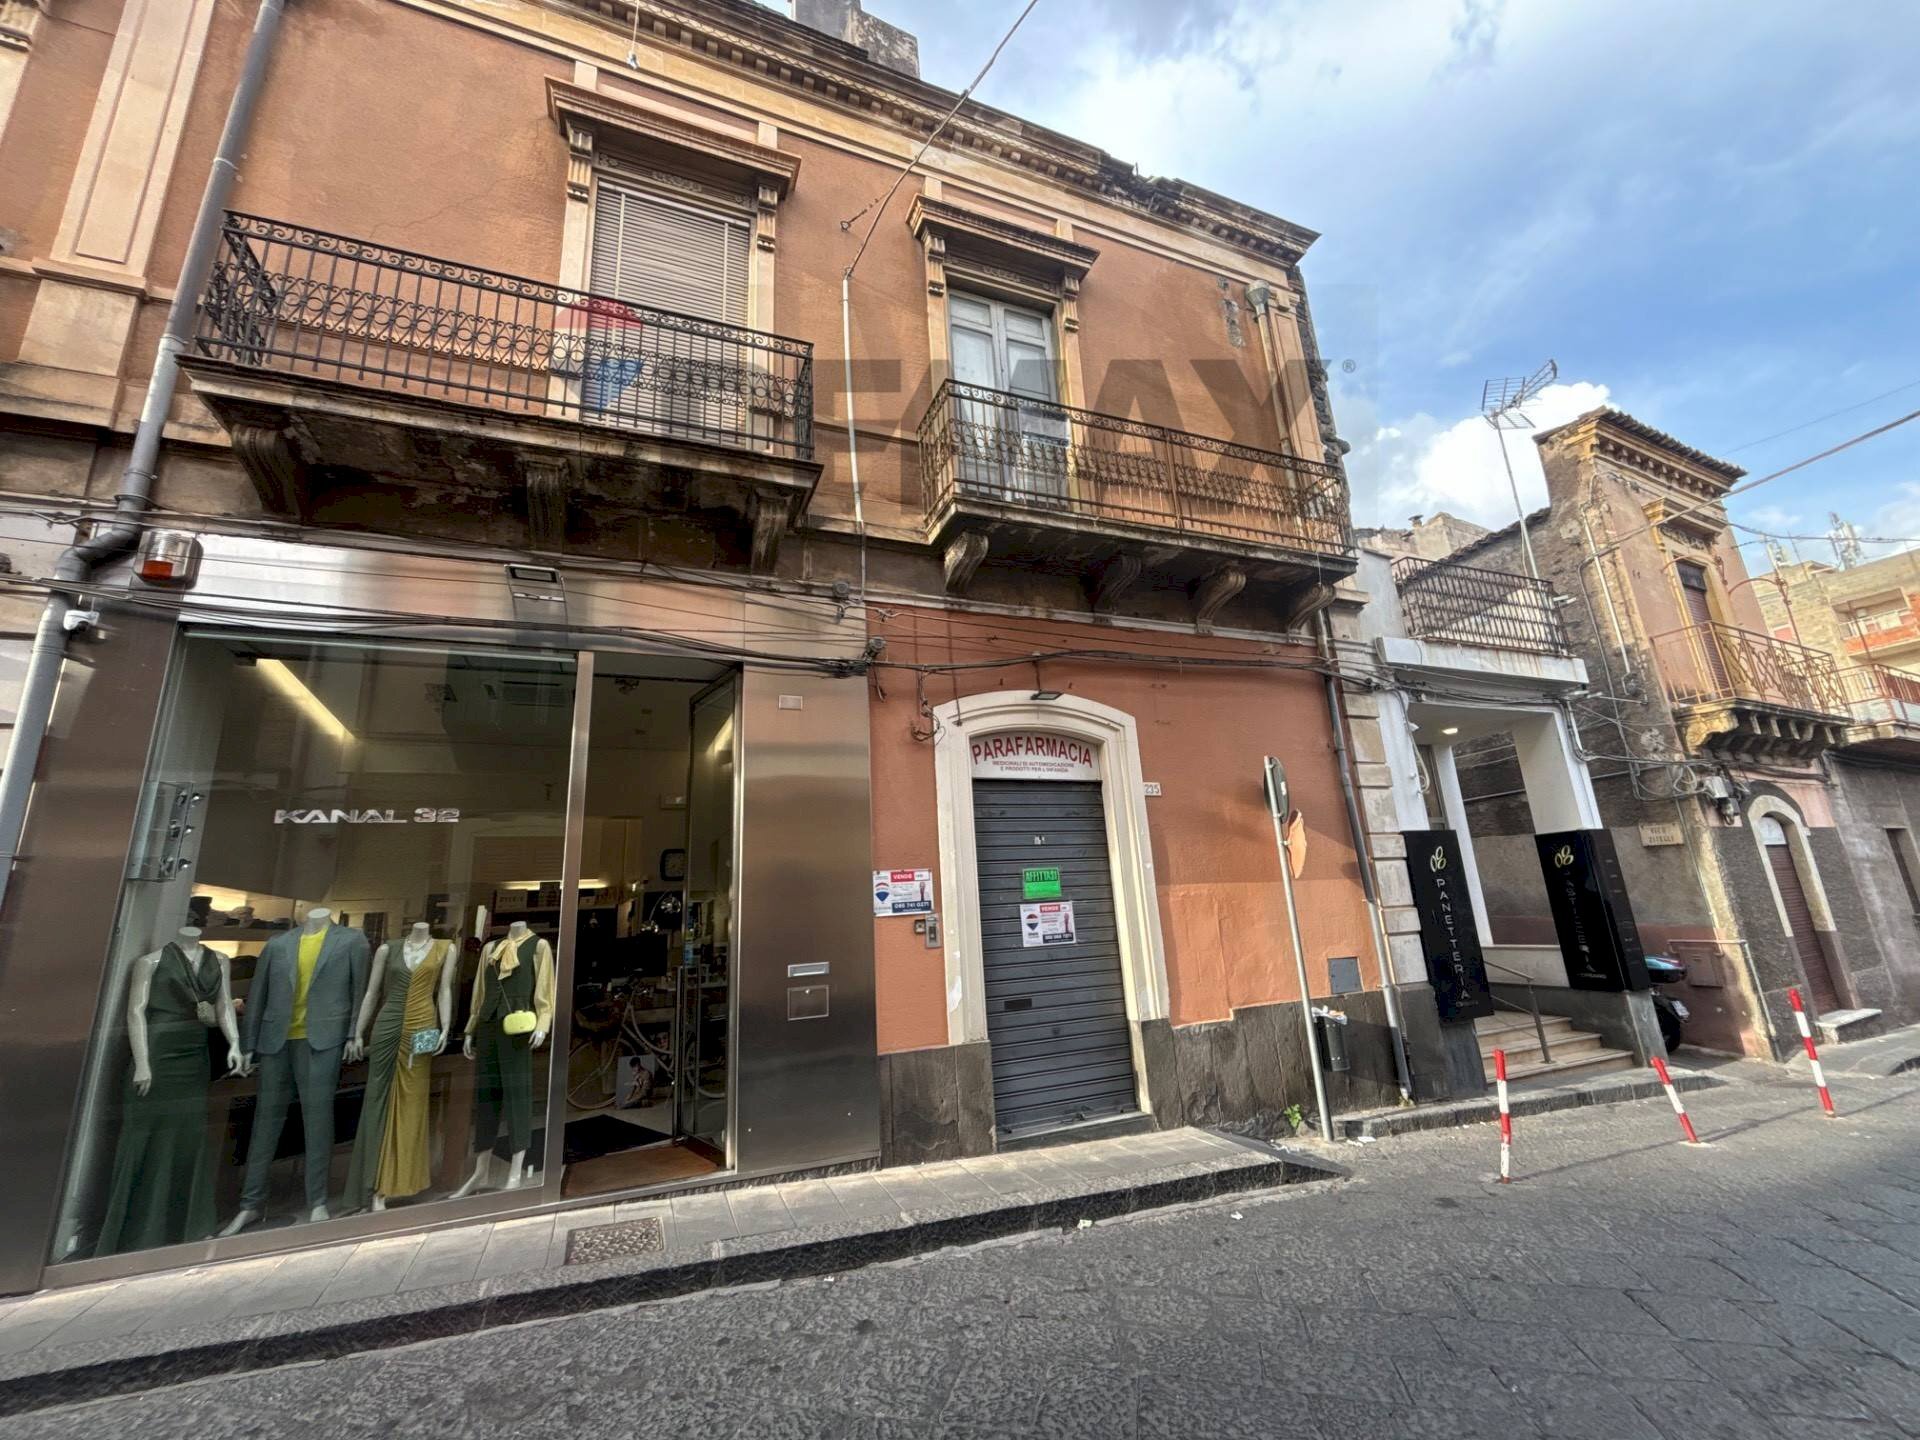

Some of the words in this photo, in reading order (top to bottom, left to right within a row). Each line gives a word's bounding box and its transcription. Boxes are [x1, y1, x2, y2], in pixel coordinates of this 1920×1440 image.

[971, 736, 1093, 768] PARAFARMACIA
[1144, 784, 1160, 794] 235
[273, 809, 408, 824] KANAL
[413, 808, 461, 823] 32
[1025, 870, 1058, 881] AFFITTASI
[1436, 878, 1470, 1000] PANETTERIA
